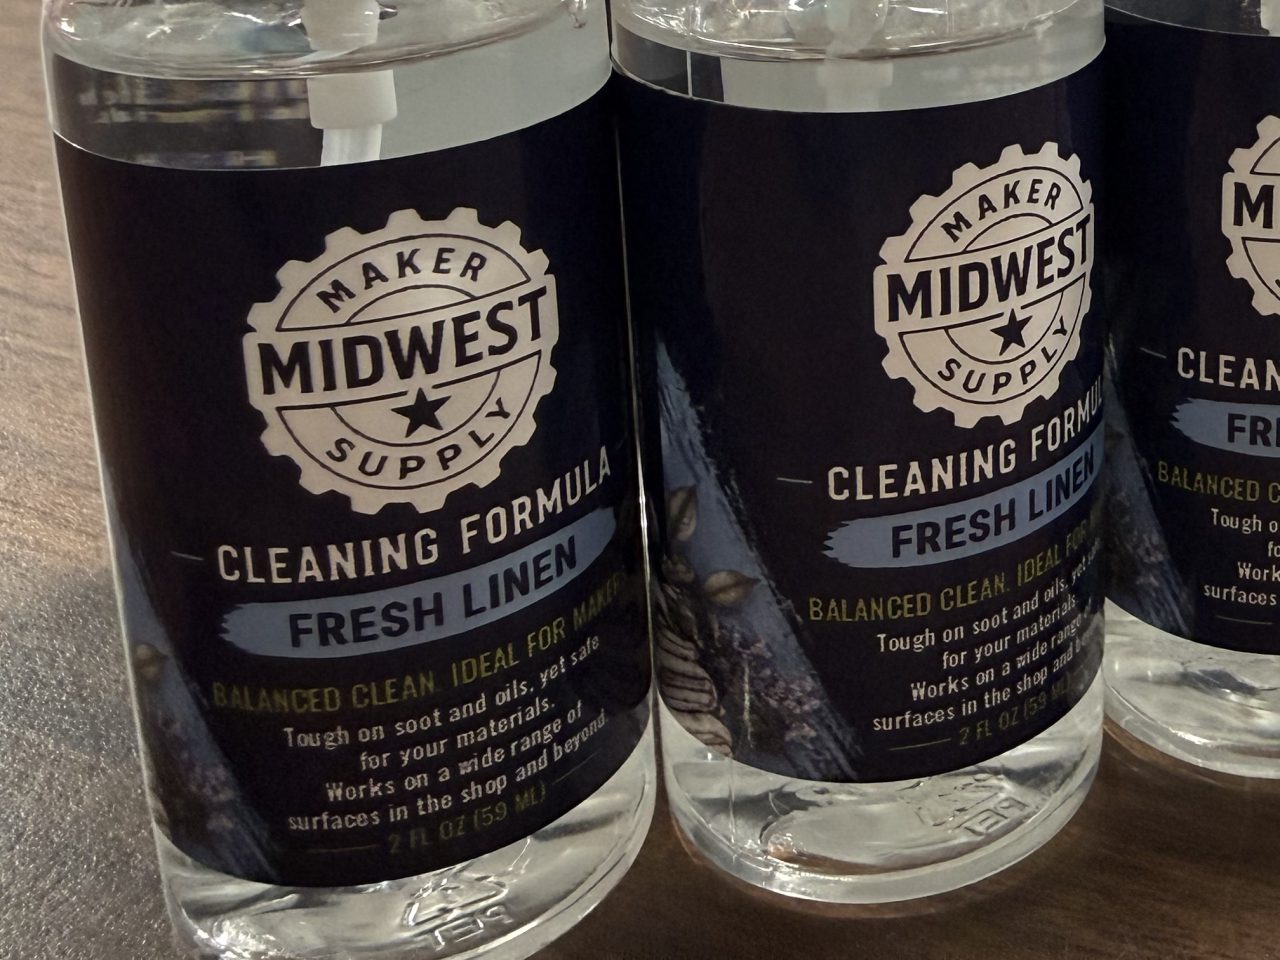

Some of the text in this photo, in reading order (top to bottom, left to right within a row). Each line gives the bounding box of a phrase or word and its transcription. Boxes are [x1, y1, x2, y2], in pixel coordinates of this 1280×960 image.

[941, 178, 1061, 243] MAKER
[317, 248, 487, 313] MAKER
[887, 213, 1091, 323] MIDWEST
[257, 286, 547, 395] MIDWEST
[937, 315, 1067, 395] SUPPLY
[325, 397, 511, 480] SUPPLY
[828, 439, 1016, 501] CLEANING
[218, 445, 611, 584] CLEANING FORMULA
[892, 498, 1016, 558] FRESH
[1029, 444, 1094, 520] LINEN
[1158, 461, 1260, 502] BALANCED
[1211, 508, 1261, 534] Tough
[289, 536, 577, 647] FRESH LINEN
[809, 593, 932, 621] BALANCED
[941, 571, 1010, 610] CLEAN.
[1017, 547, 1061, 587] IDEAL
[878, 629, 935, 652] Tough
[943, 625, 964, 642] on
[973, 608, 1008, 635] soot
[1013, 592, 1039, 618] and
[1204, 583, 1277, 606] surfaces
[213, 683, 340, 712] BALANCED
[452, 646, 519, 687] IDEAL
[528, 617, 565, 657] FOR
[873, 708, 955, 731] surfaces
[962, 699, 977, 716] in
[985, 686, 1010, 710] the
[1017, 668, 1047, 696] shop
[1053, 648, 1074, 673] and
[911, 679, 968, 701] Works
[977, 671, 995, 685] on
[1002, 663, 1010, 676] a
[1016, 640, 1048, 667] wide
[943, 651, 965, 669] for
[974, 637, 1009, 664] your
[284, 726, 349, 750] Tough
[358, 724, 384, 743] on
[395, 710, 439, 737] soot
[449, 699, 487, 729] and
[540, 657, 566, 688] yet
[571, 635, 599, 665] safe
[325, 700, 583, 803] Works on a wide range of
[361, 701, 555, 771] for your materials.
[288, 809, 379, 831] surfaces
[388, 804, 408, 823] in
[417, 789, 452, 815] the
[461, 775, 507, 806] shop
[515, 755, 548, 785] and
